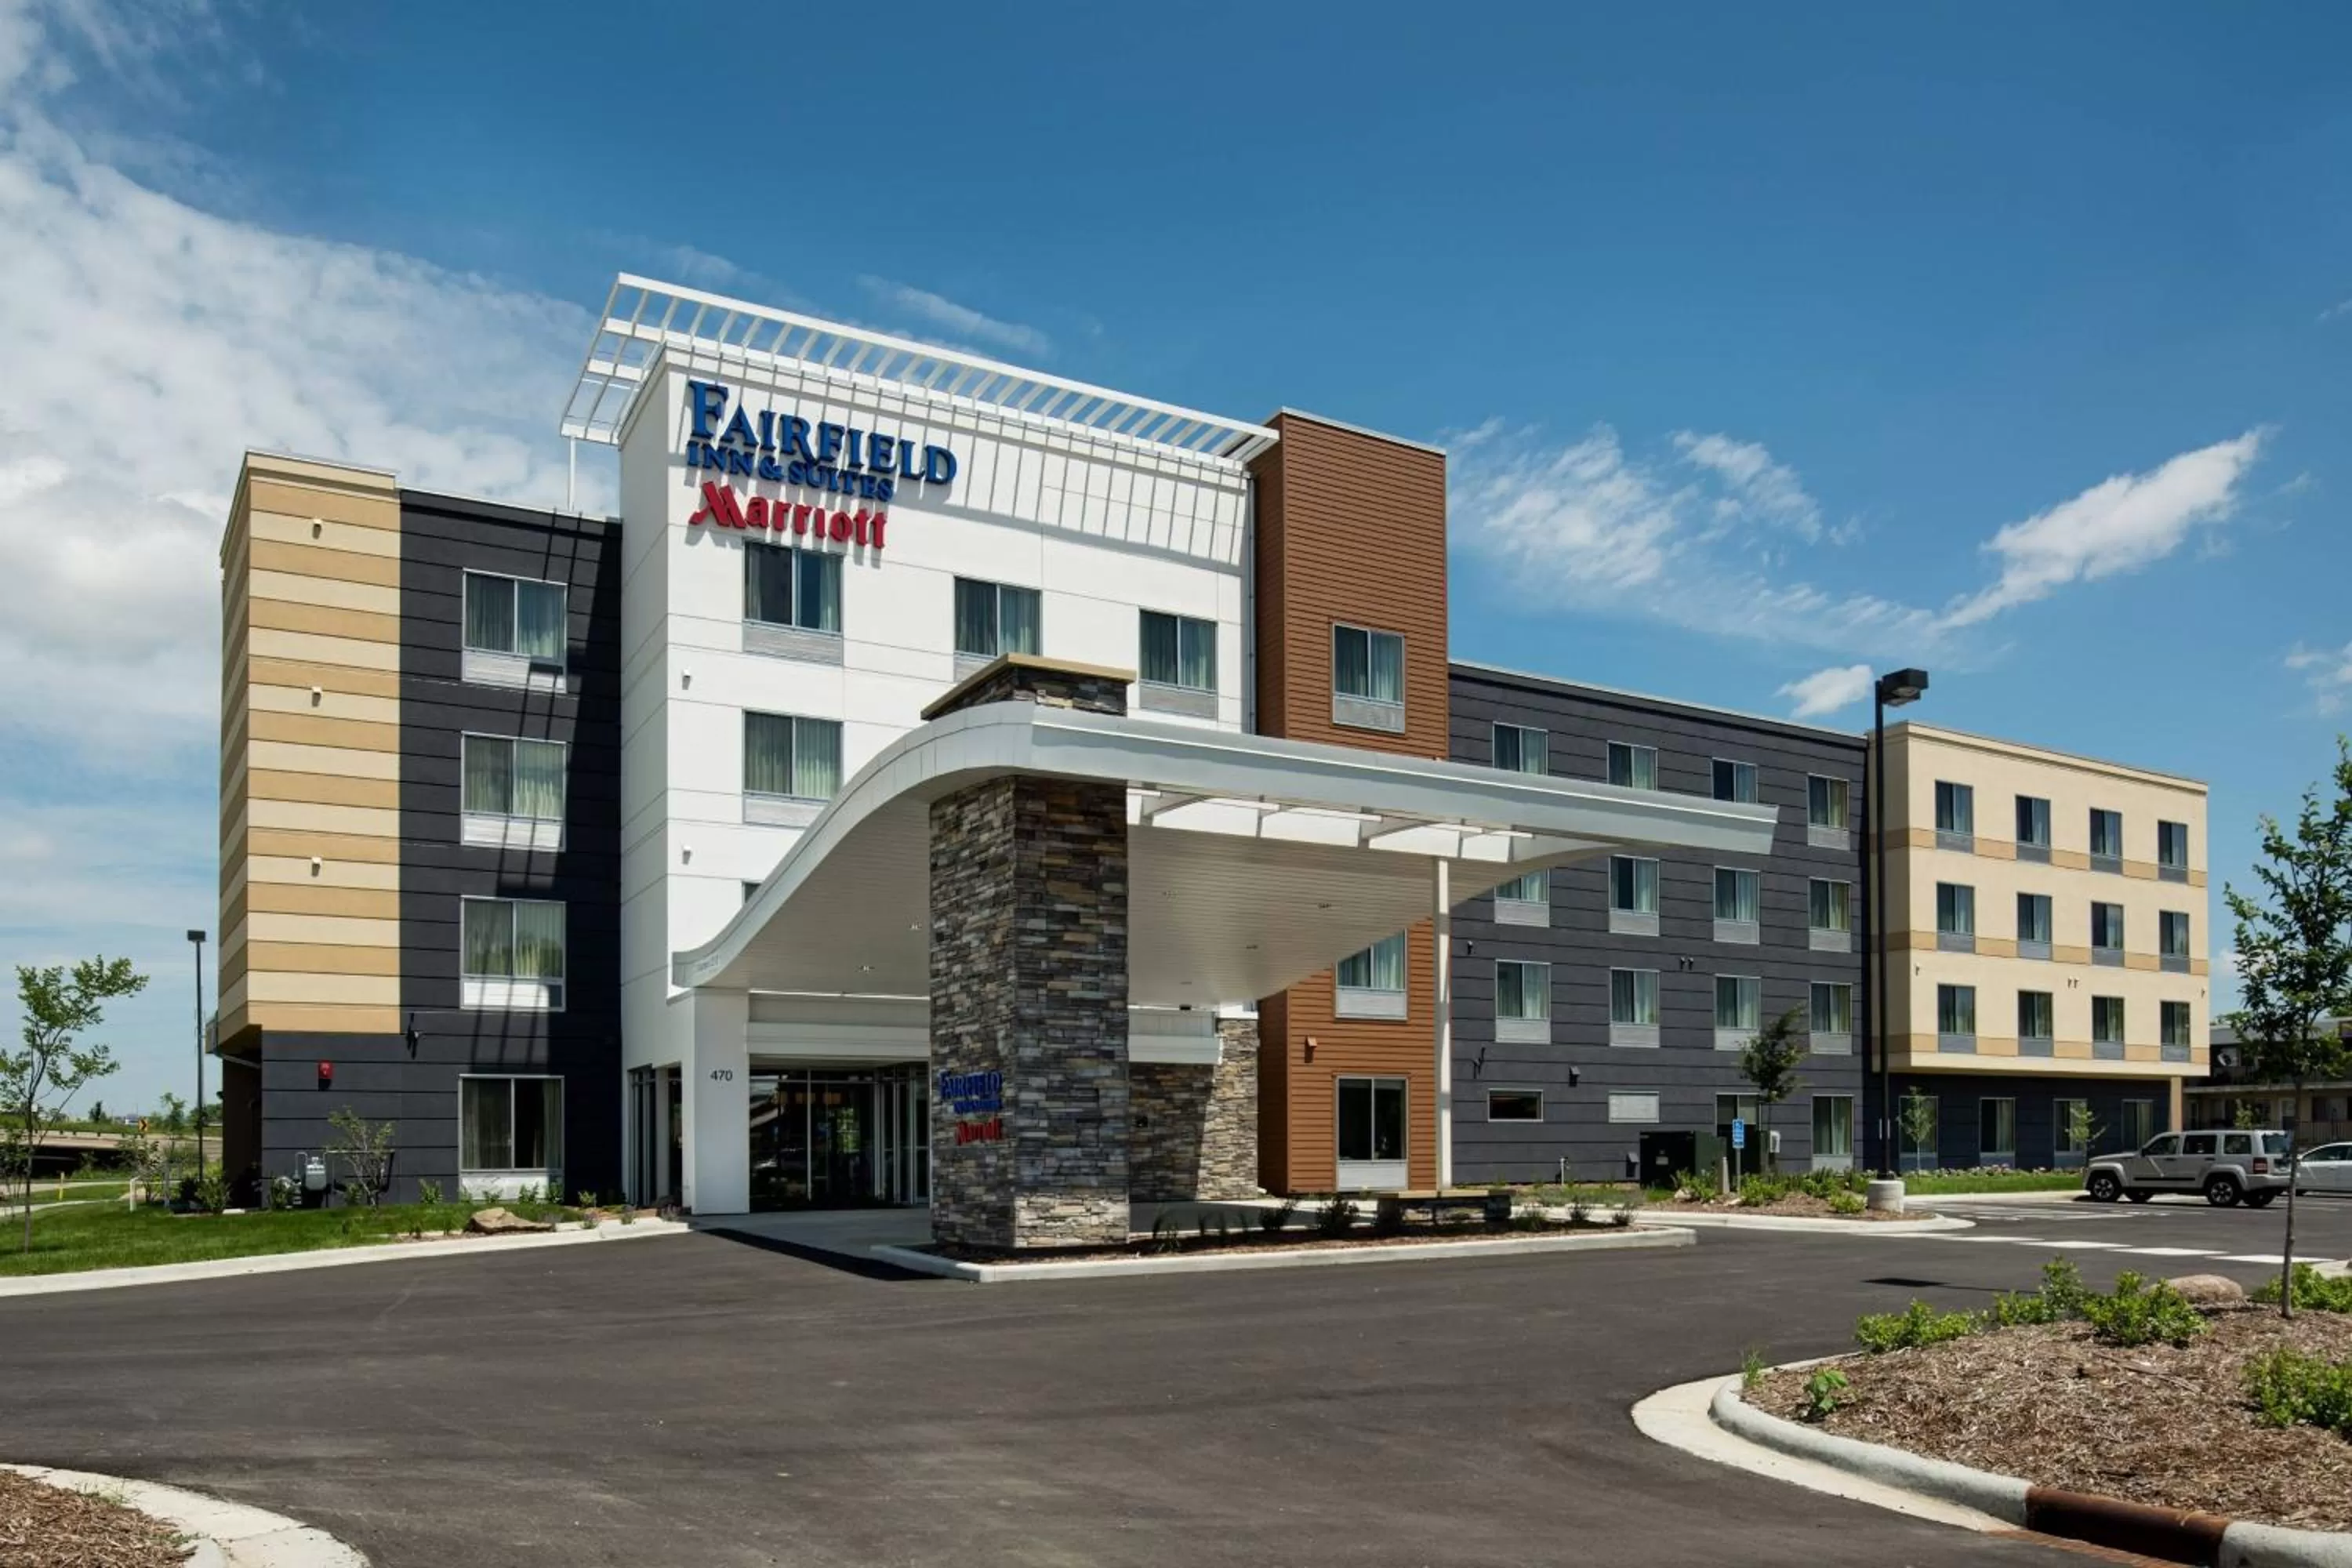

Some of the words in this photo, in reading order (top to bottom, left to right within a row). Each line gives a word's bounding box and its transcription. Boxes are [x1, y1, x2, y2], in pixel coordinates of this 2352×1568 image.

[689, 379, 957, 485] FAIRFIELD
[687, 440, 753, 477] INN
[758, 456, 782, 481] &
[788, 459, 894, 503] SUITES
[688, 481, 887, 550] Marriott
[710, 1069, 733, 1082] 470
